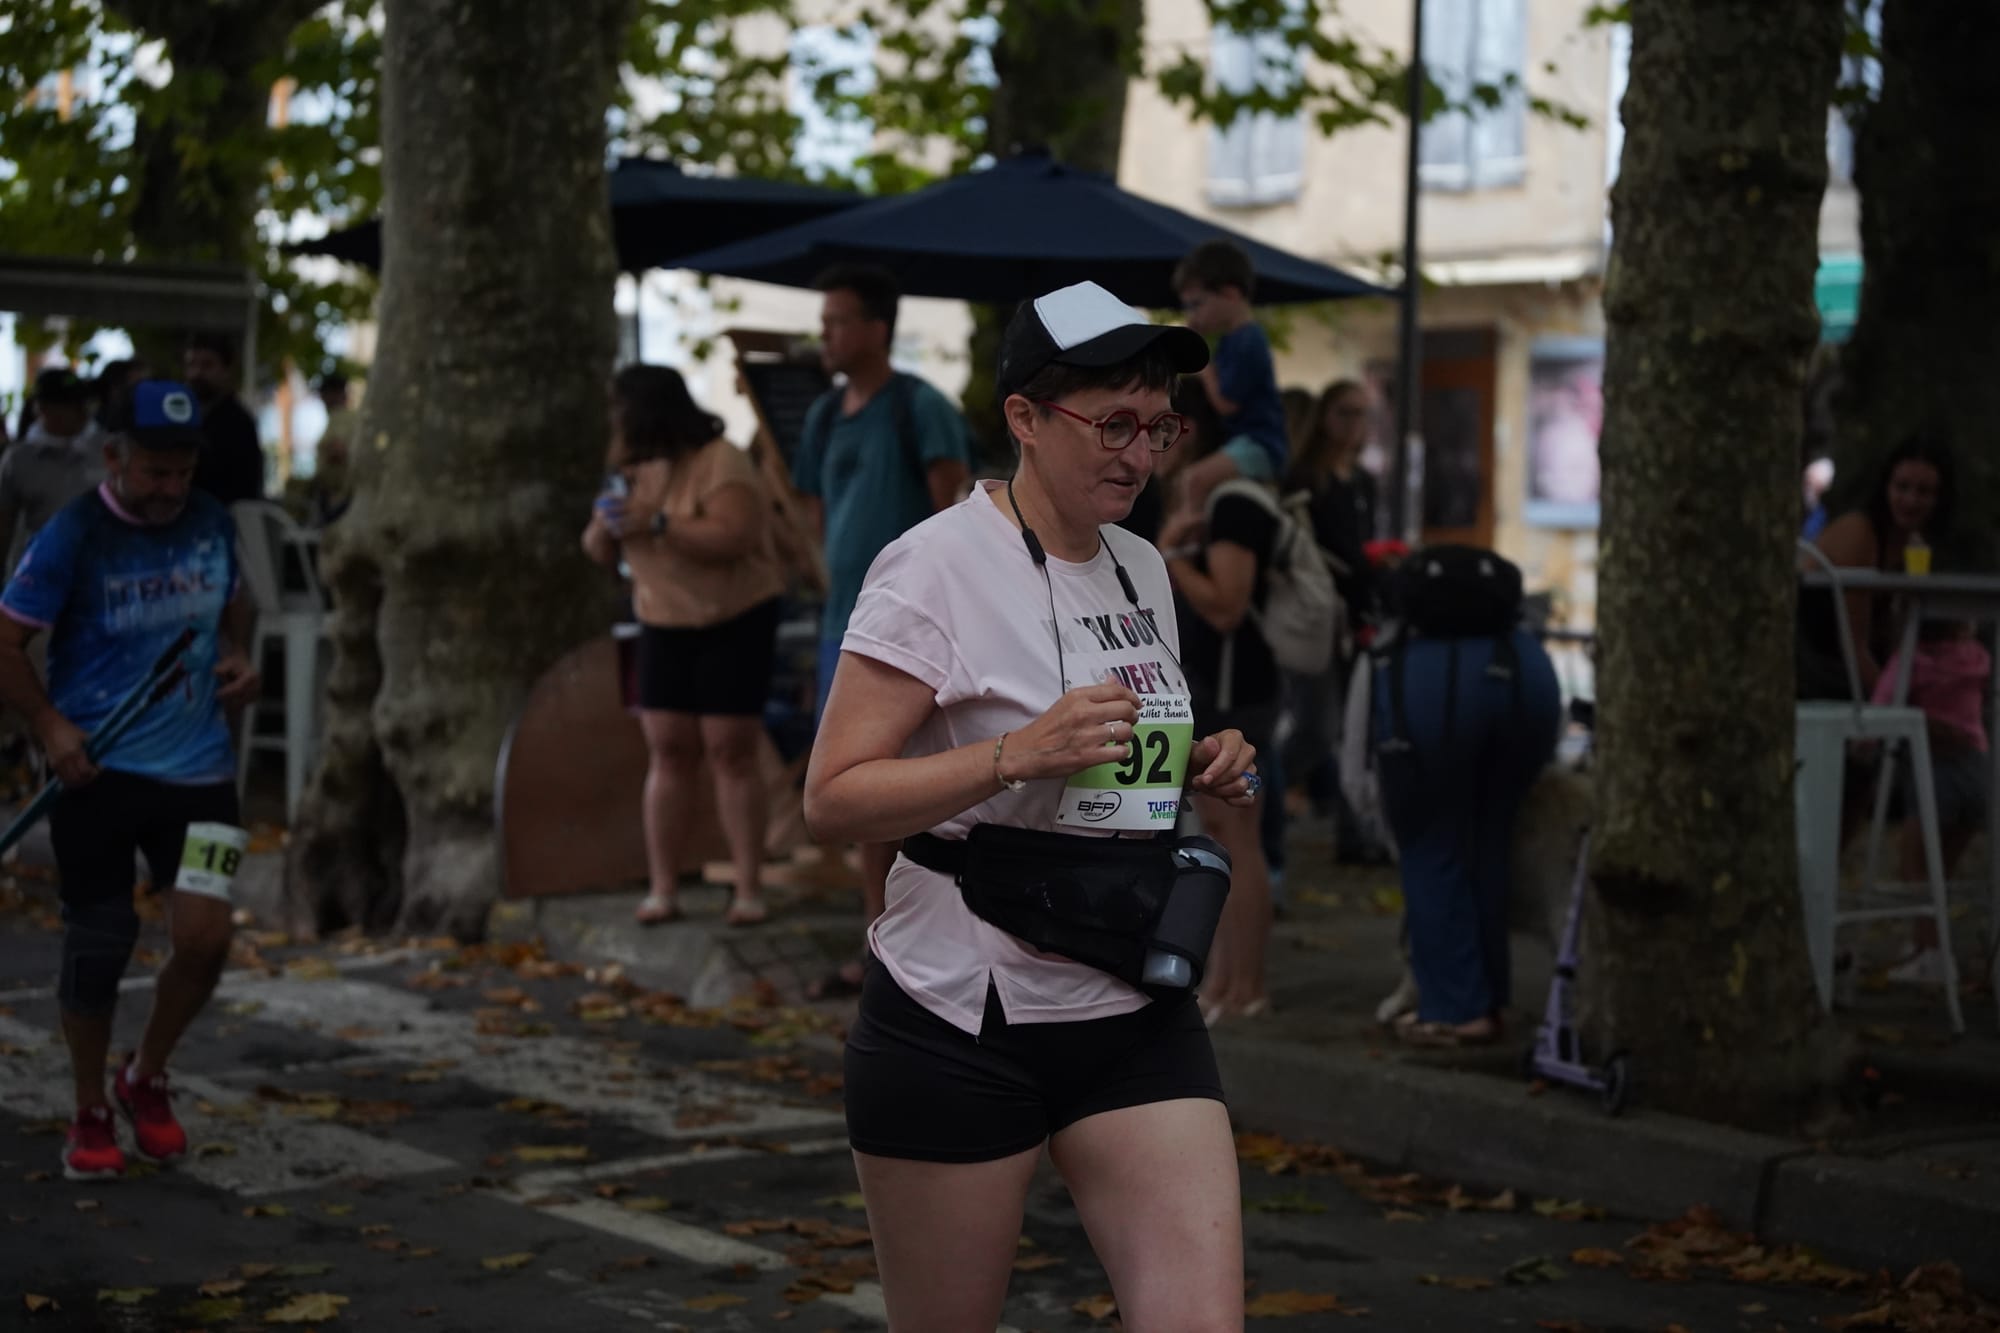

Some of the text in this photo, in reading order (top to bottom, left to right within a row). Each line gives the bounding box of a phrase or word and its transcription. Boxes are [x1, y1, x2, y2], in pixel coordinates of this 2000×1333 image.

[1115, 731, 1171, 785] 92
[1077, 801, 1115, 812] BFP
[199, 841, 242, 877] 18
